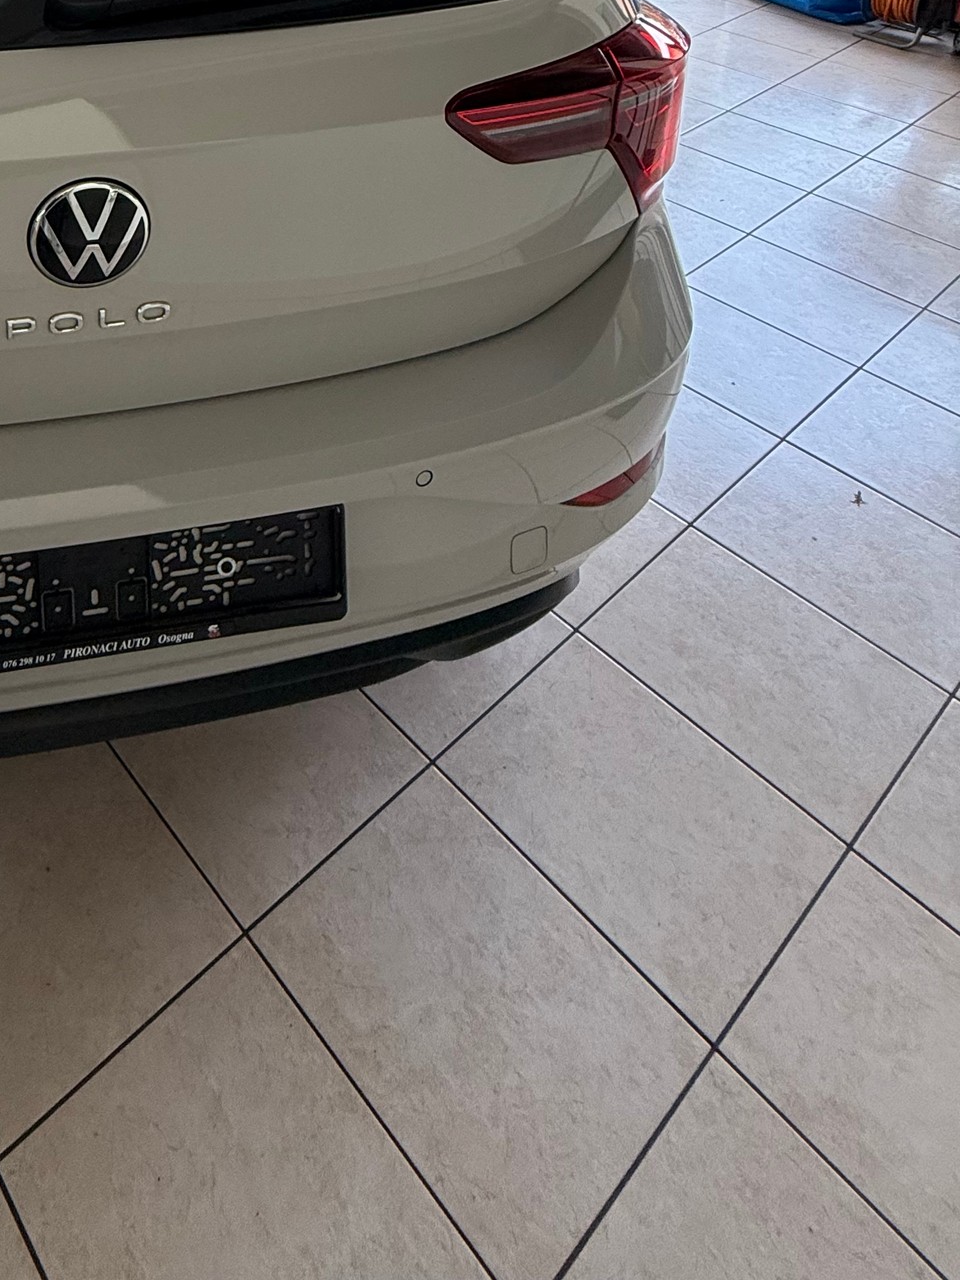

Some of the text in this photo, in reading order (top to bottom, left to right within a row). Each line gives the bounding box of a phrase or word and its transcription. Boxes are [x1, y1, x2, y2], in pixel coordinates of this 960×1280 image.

[37, 182, 147, 283] VW
[6, 300, 171, 339] POLO
[2, 631, 194, 669] 076 298 10 17 PIRONACI AUTO Osogna
